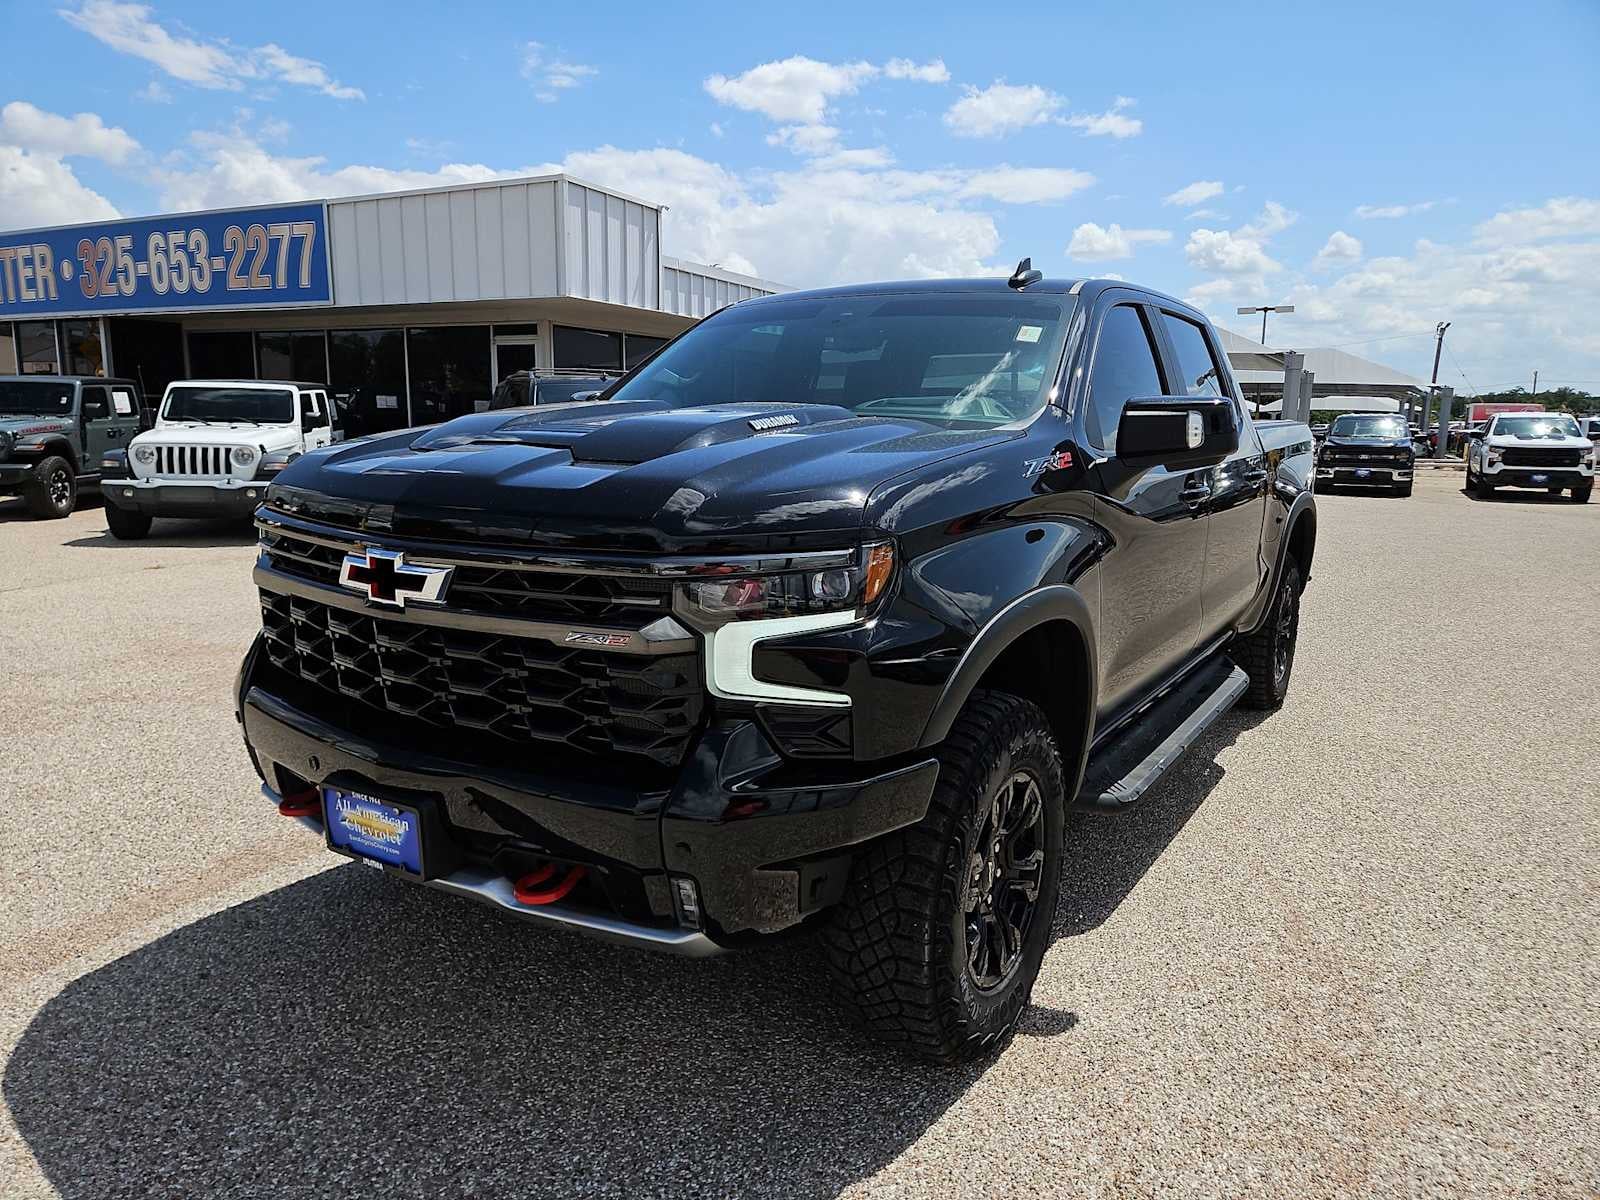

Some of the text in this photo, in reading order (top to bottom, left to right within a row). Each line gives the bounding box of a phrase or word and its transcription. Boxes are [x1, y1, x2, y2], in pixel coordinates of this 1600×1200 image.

[0, 221, 316, 304] TER 325-653-2277
[748, 414, 800, 431] DURAMAX
[1022, 451, 1073, 479] ZR2
[564, 631, 632, 647] ZR2
[335, 798, 409, 832] All American
[345, 818, 401, 845] Chevrolet
